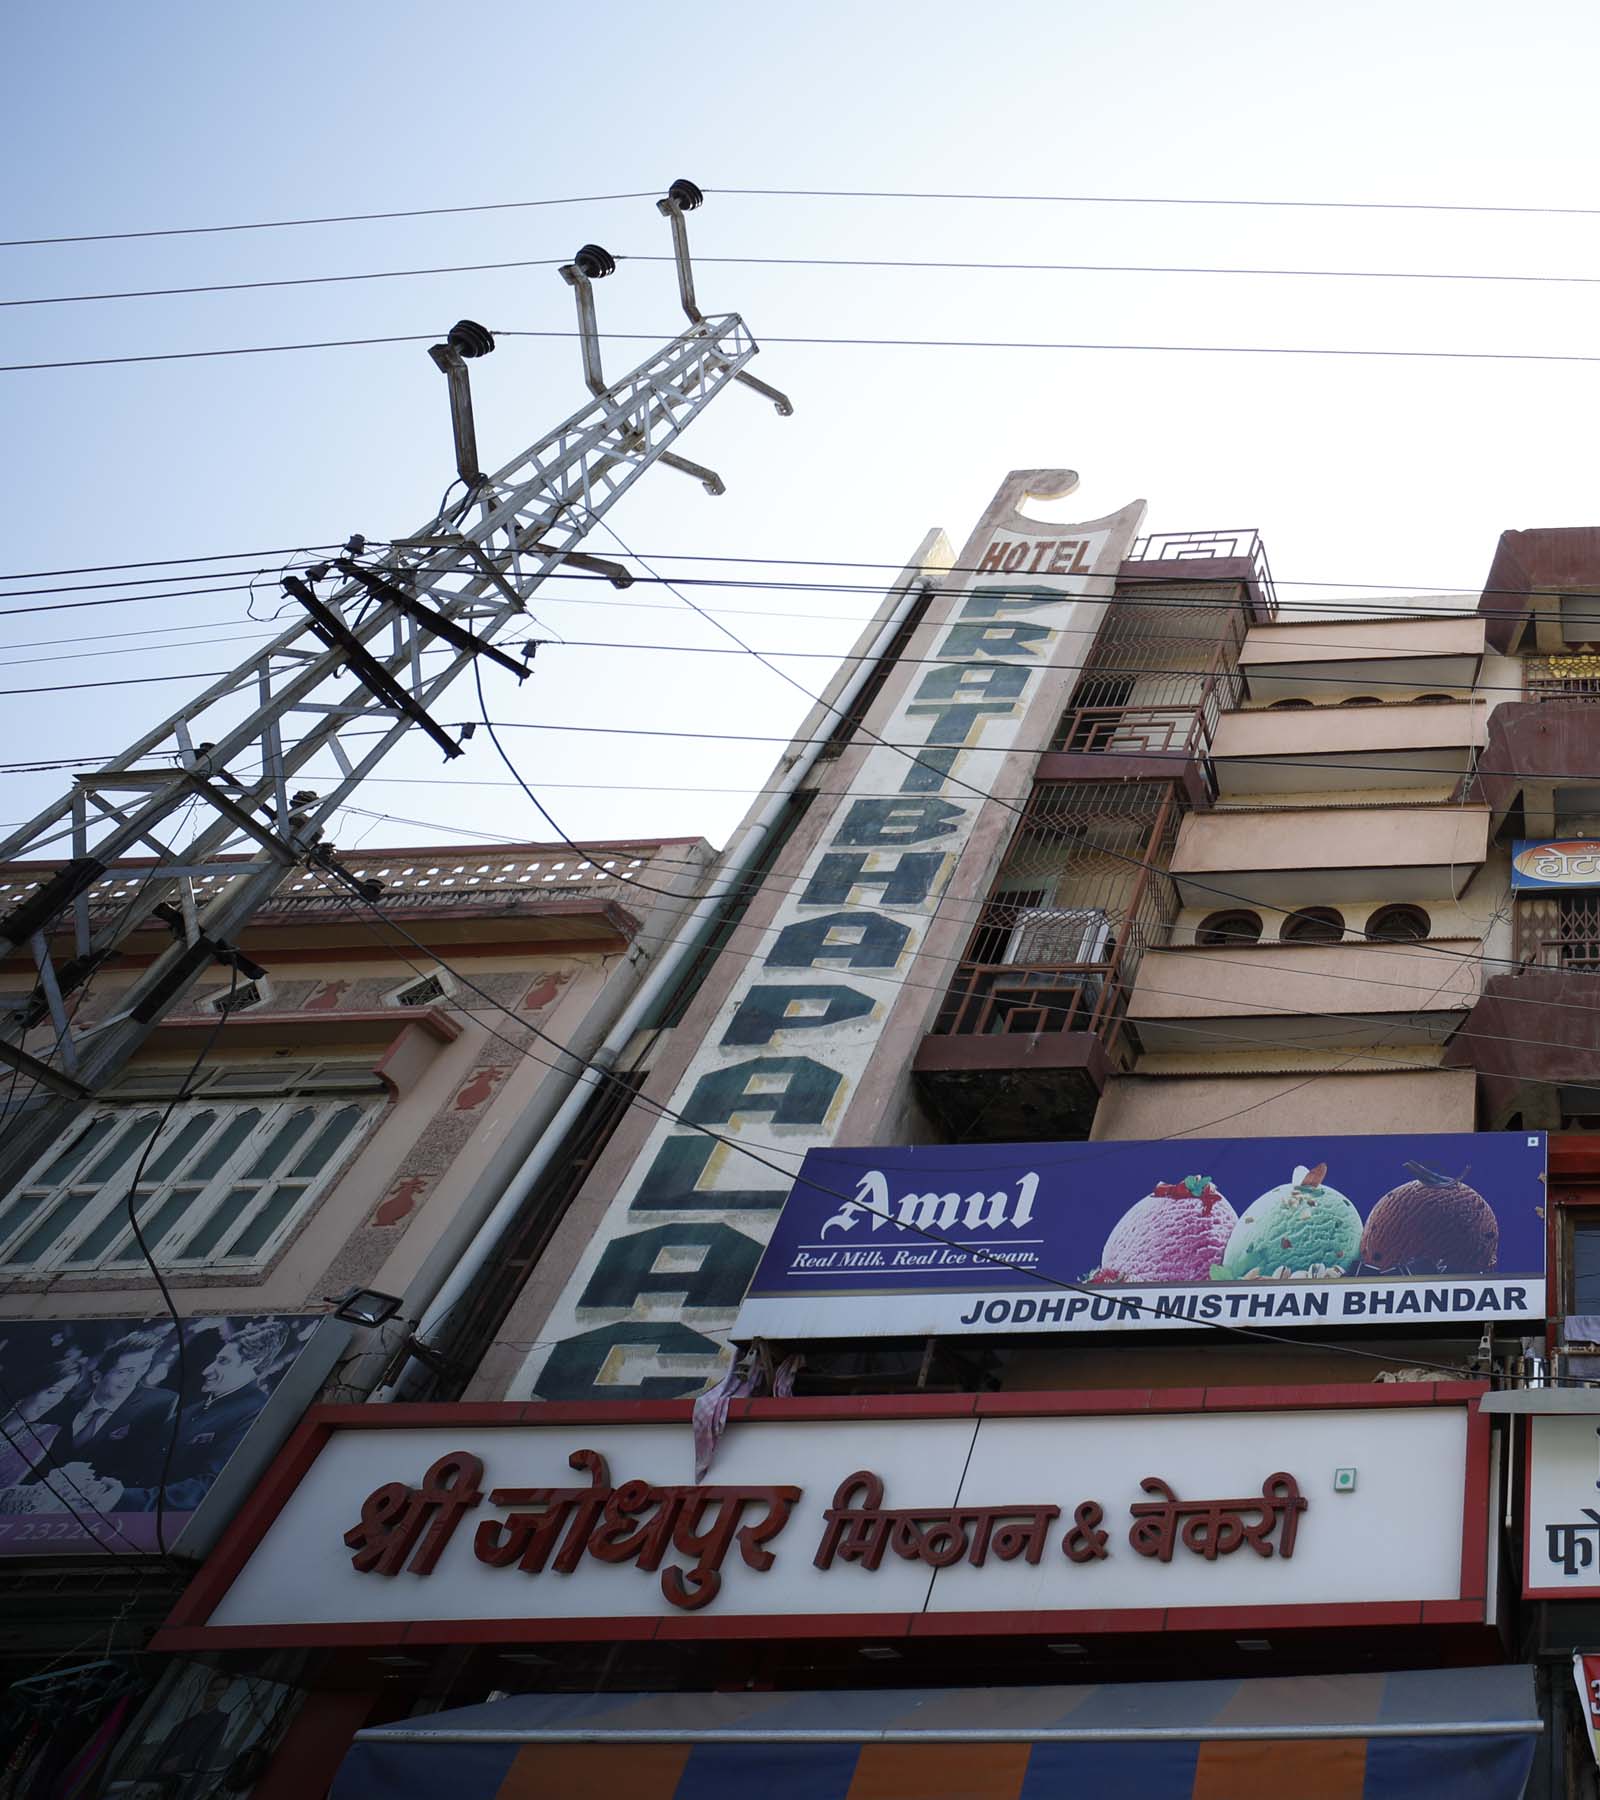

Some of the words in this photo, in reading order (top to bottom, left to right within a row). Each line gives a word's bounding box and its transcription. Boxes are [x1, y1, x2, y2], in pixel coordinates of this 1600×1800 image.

[977, 540, 1092, 576] HOTEL
[532, 984, 878, 1401] PALAC
[820, 1170, 1041, 1240] Amul
[791, 1252, 834, 1268] Real
[838, 1250, 886, 1267] Milk.
[891, 1250, 935, 1266] Real
[939, 1249, 967, 1265] Ice
[972, 1248, 1040, 1264] Cream.
[960, 1297, 1144, 1325] JODHPUR
[1153, 1289, 1330, 1321] MISTHAN
[1341, 1286, 1528, 1316] BHANDAR
[344, 1450, 485, 1577] श्री
[474, 1448, 804, 1611] जोधपुर
[813, 1470, 1062, 1571] मिष्ठान
[1062, 1501, 1110, 1563] &
[1129, 1471, 1308, 1563] बेकरी
